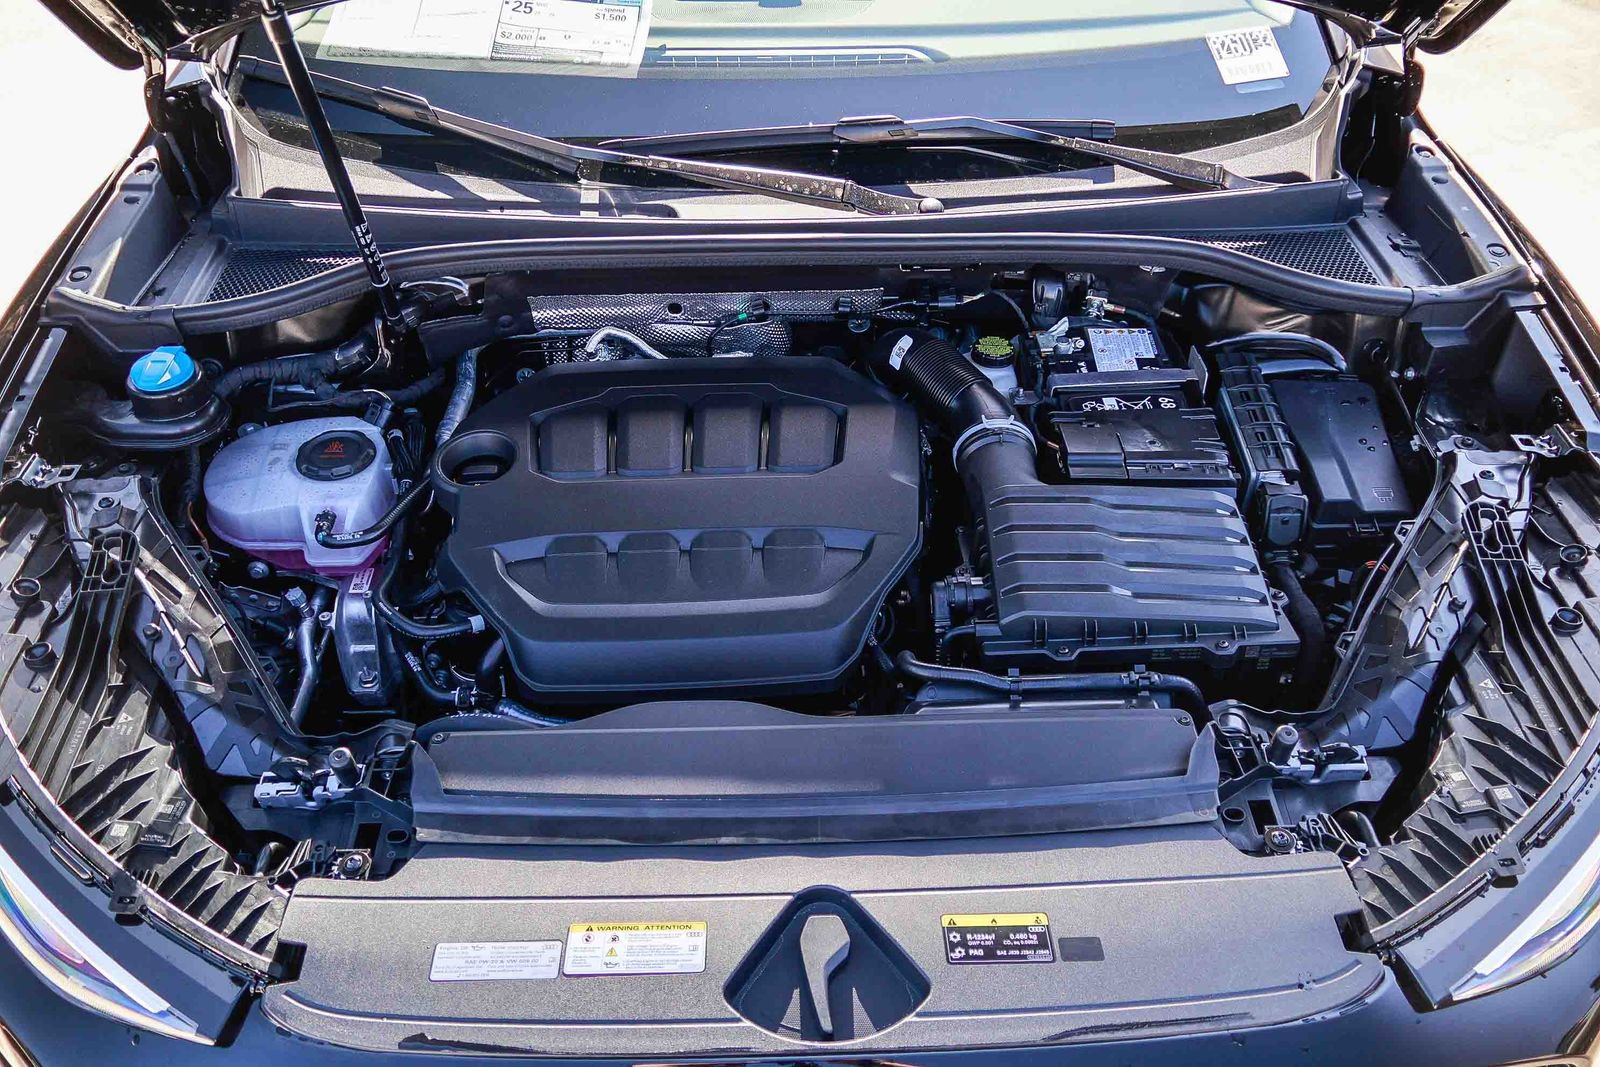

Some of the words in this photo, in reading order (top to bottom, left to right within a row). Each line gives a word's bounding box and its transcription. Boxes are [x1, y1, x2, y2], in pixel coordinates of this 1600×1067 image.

[511, 0, 534, 15] 25
[594, 13, 627, 23] $1,500
[500, 30, 533, 42] $2,000
